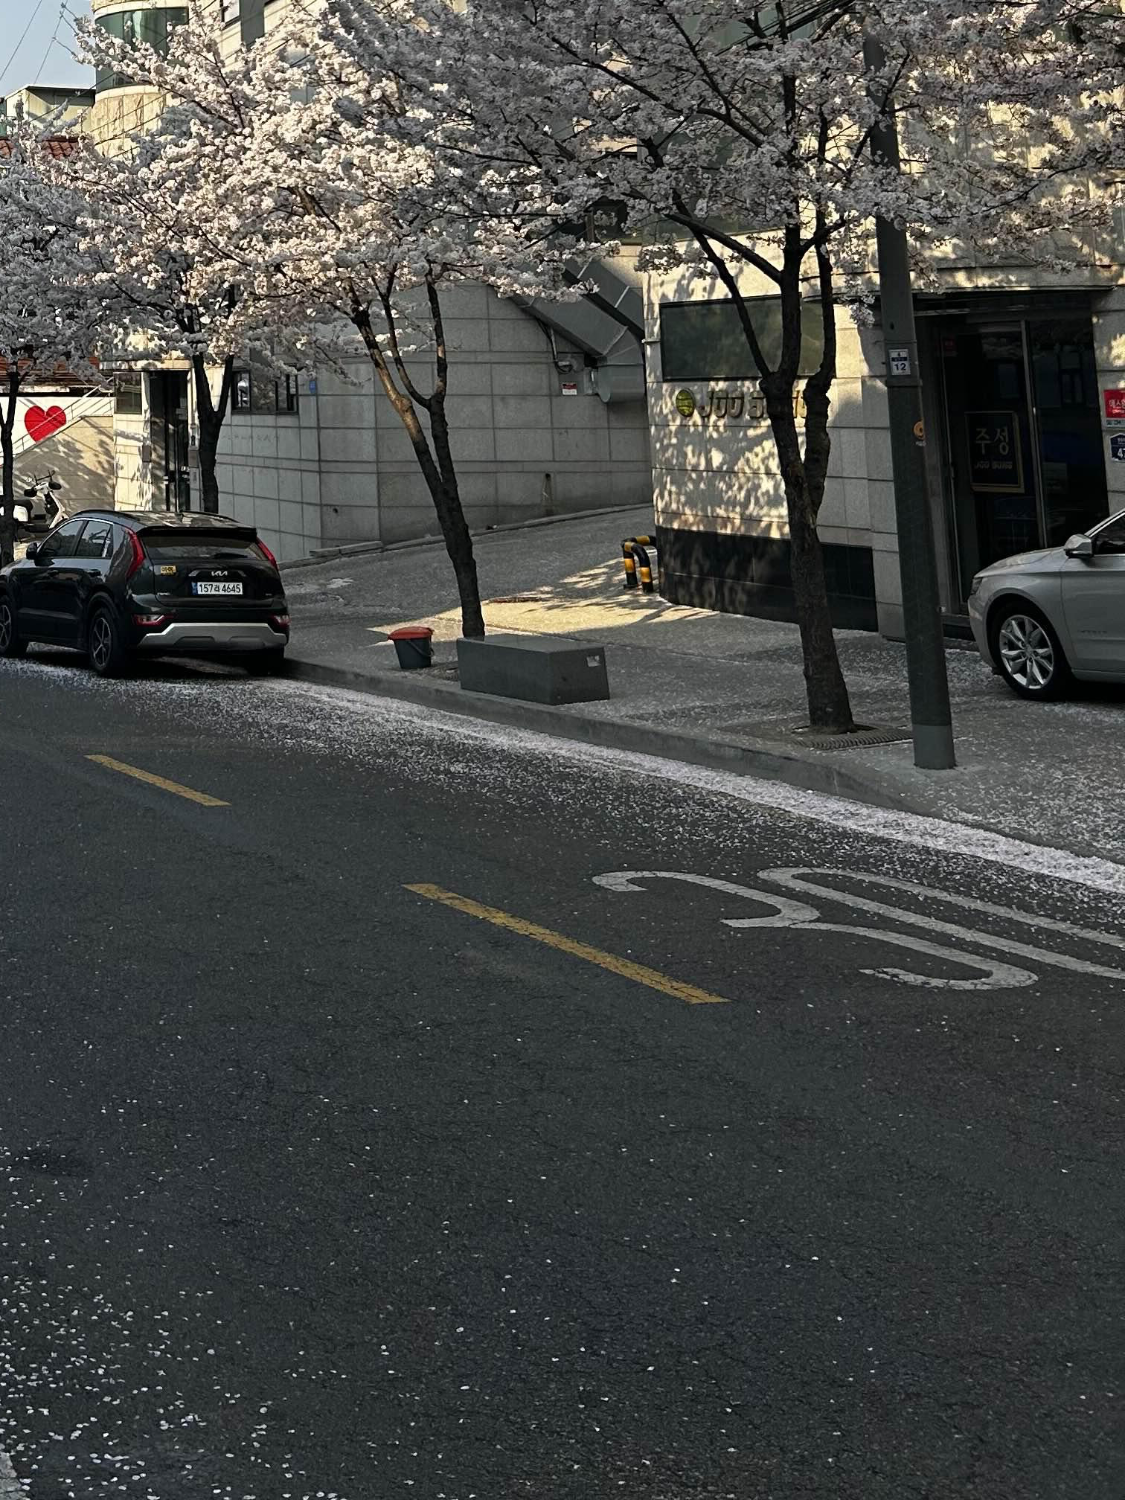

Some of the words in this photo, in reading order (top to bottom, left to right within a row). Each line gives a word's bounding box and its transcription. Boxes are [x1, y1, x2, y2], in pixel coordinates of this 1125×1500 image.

[894, 362, 907, 371] 12
[975, 426, 1010, 456] 주성
[221, 583, 241, 594] 4645
